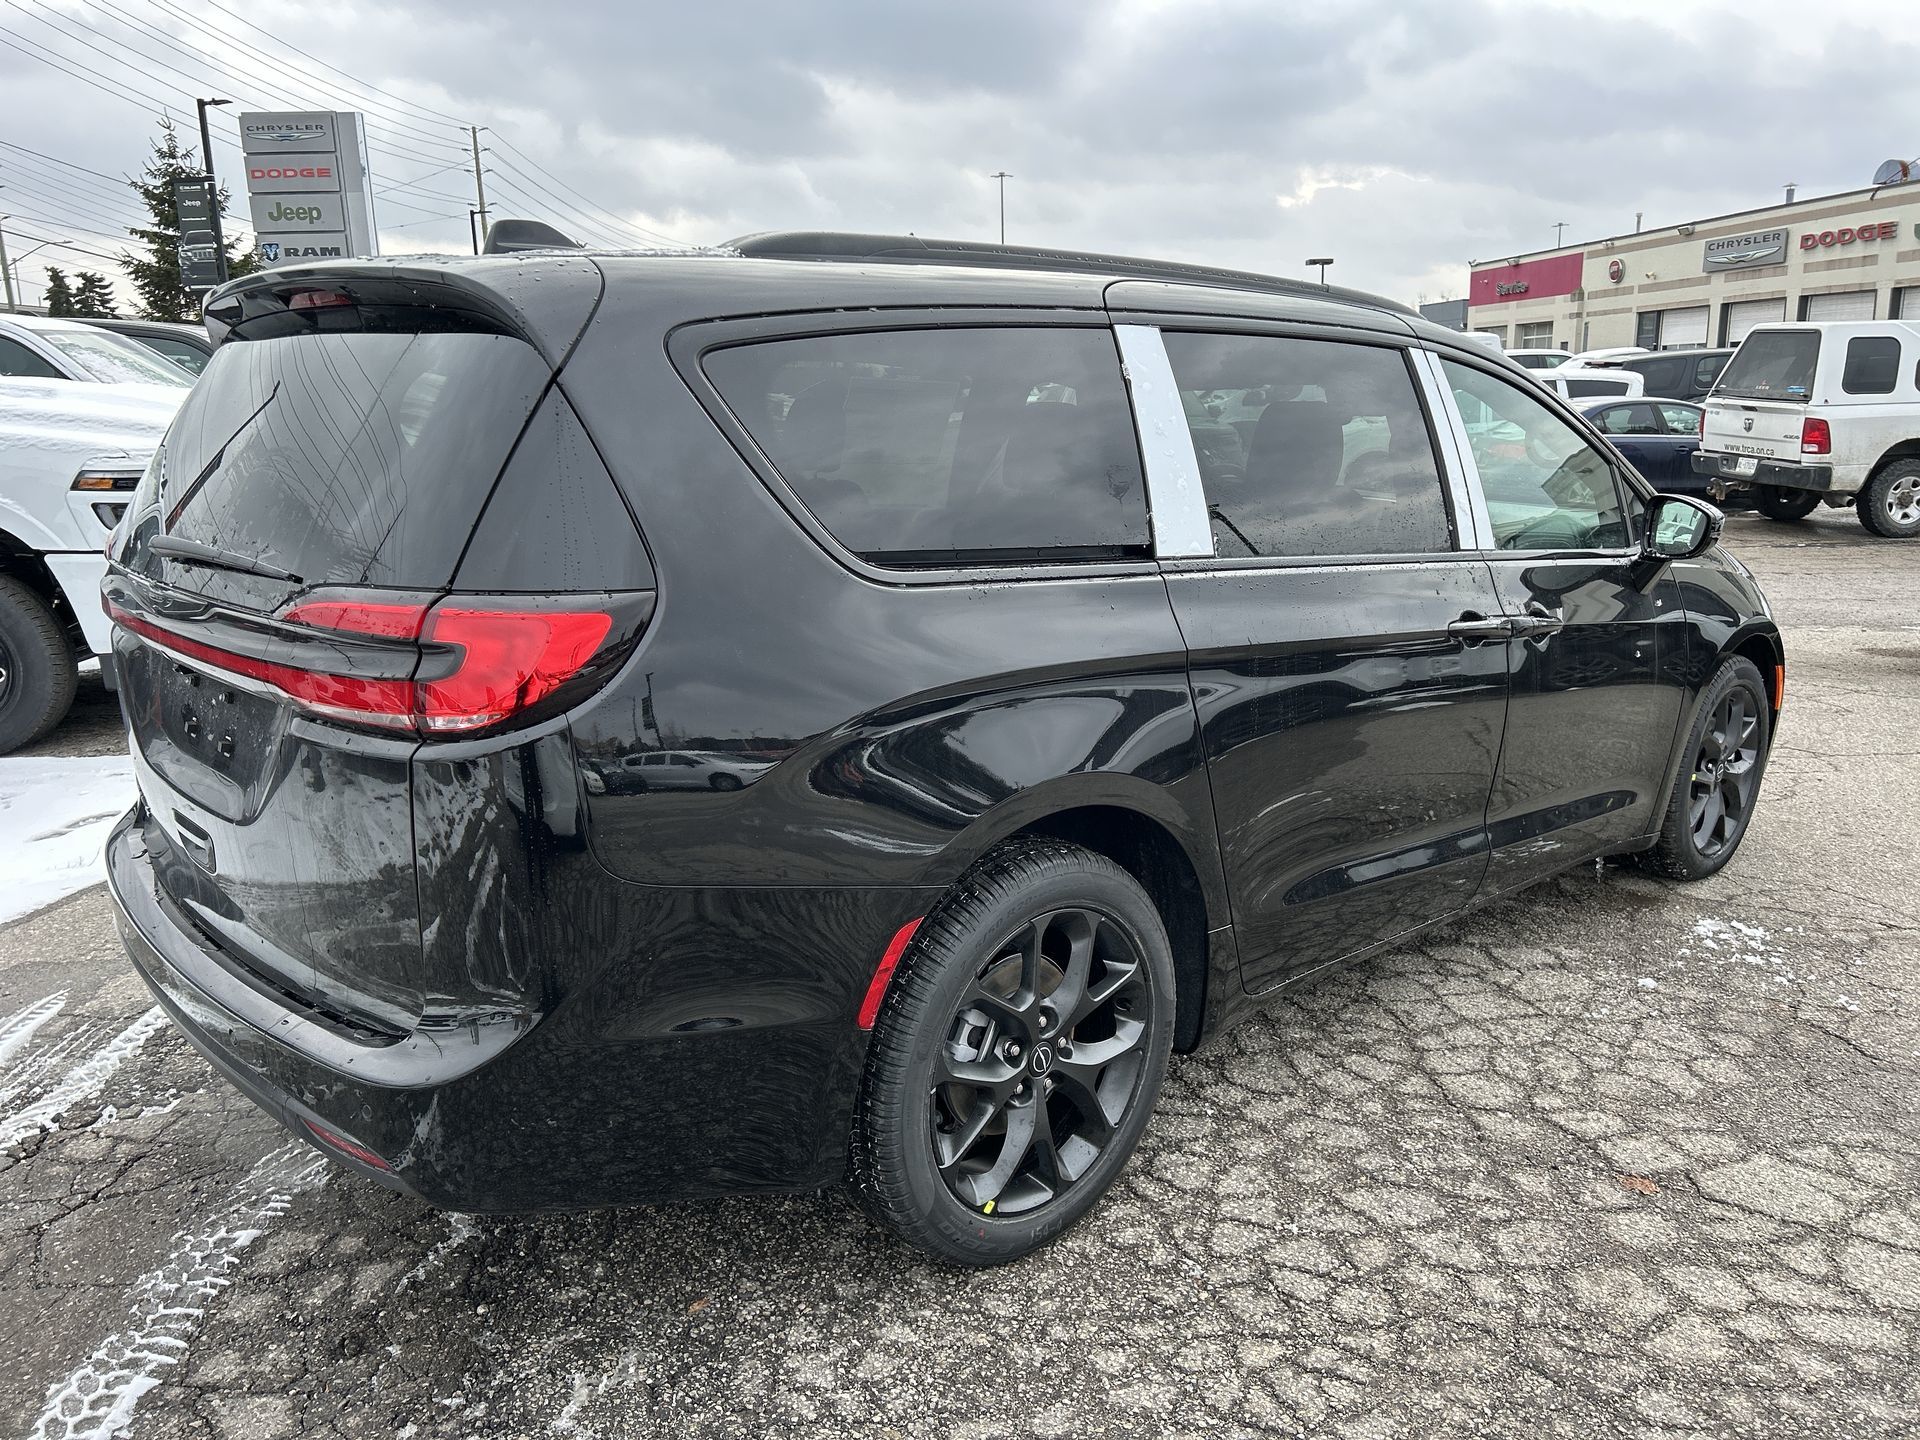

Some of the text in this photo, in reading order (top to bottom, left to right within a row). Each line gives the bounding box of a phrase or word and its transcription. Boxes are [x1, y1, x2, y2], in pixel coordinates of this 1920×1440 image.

[246, 124, 325, 132] CHRYSLER
[250, 167, 332, 179] DODGE
[182, 199, 201, 207] Jeep
[267, 201, 322, 224] Jeep
[1707, 232, 1782, 252] CHRYSLER
[1799, 221, 1899, 250] DODGE
[284, 246, 341, 257] RAM
[1495, 279, 1529, 297] Service
[1723, 443, 1775, 456] www.trca.on.ca
